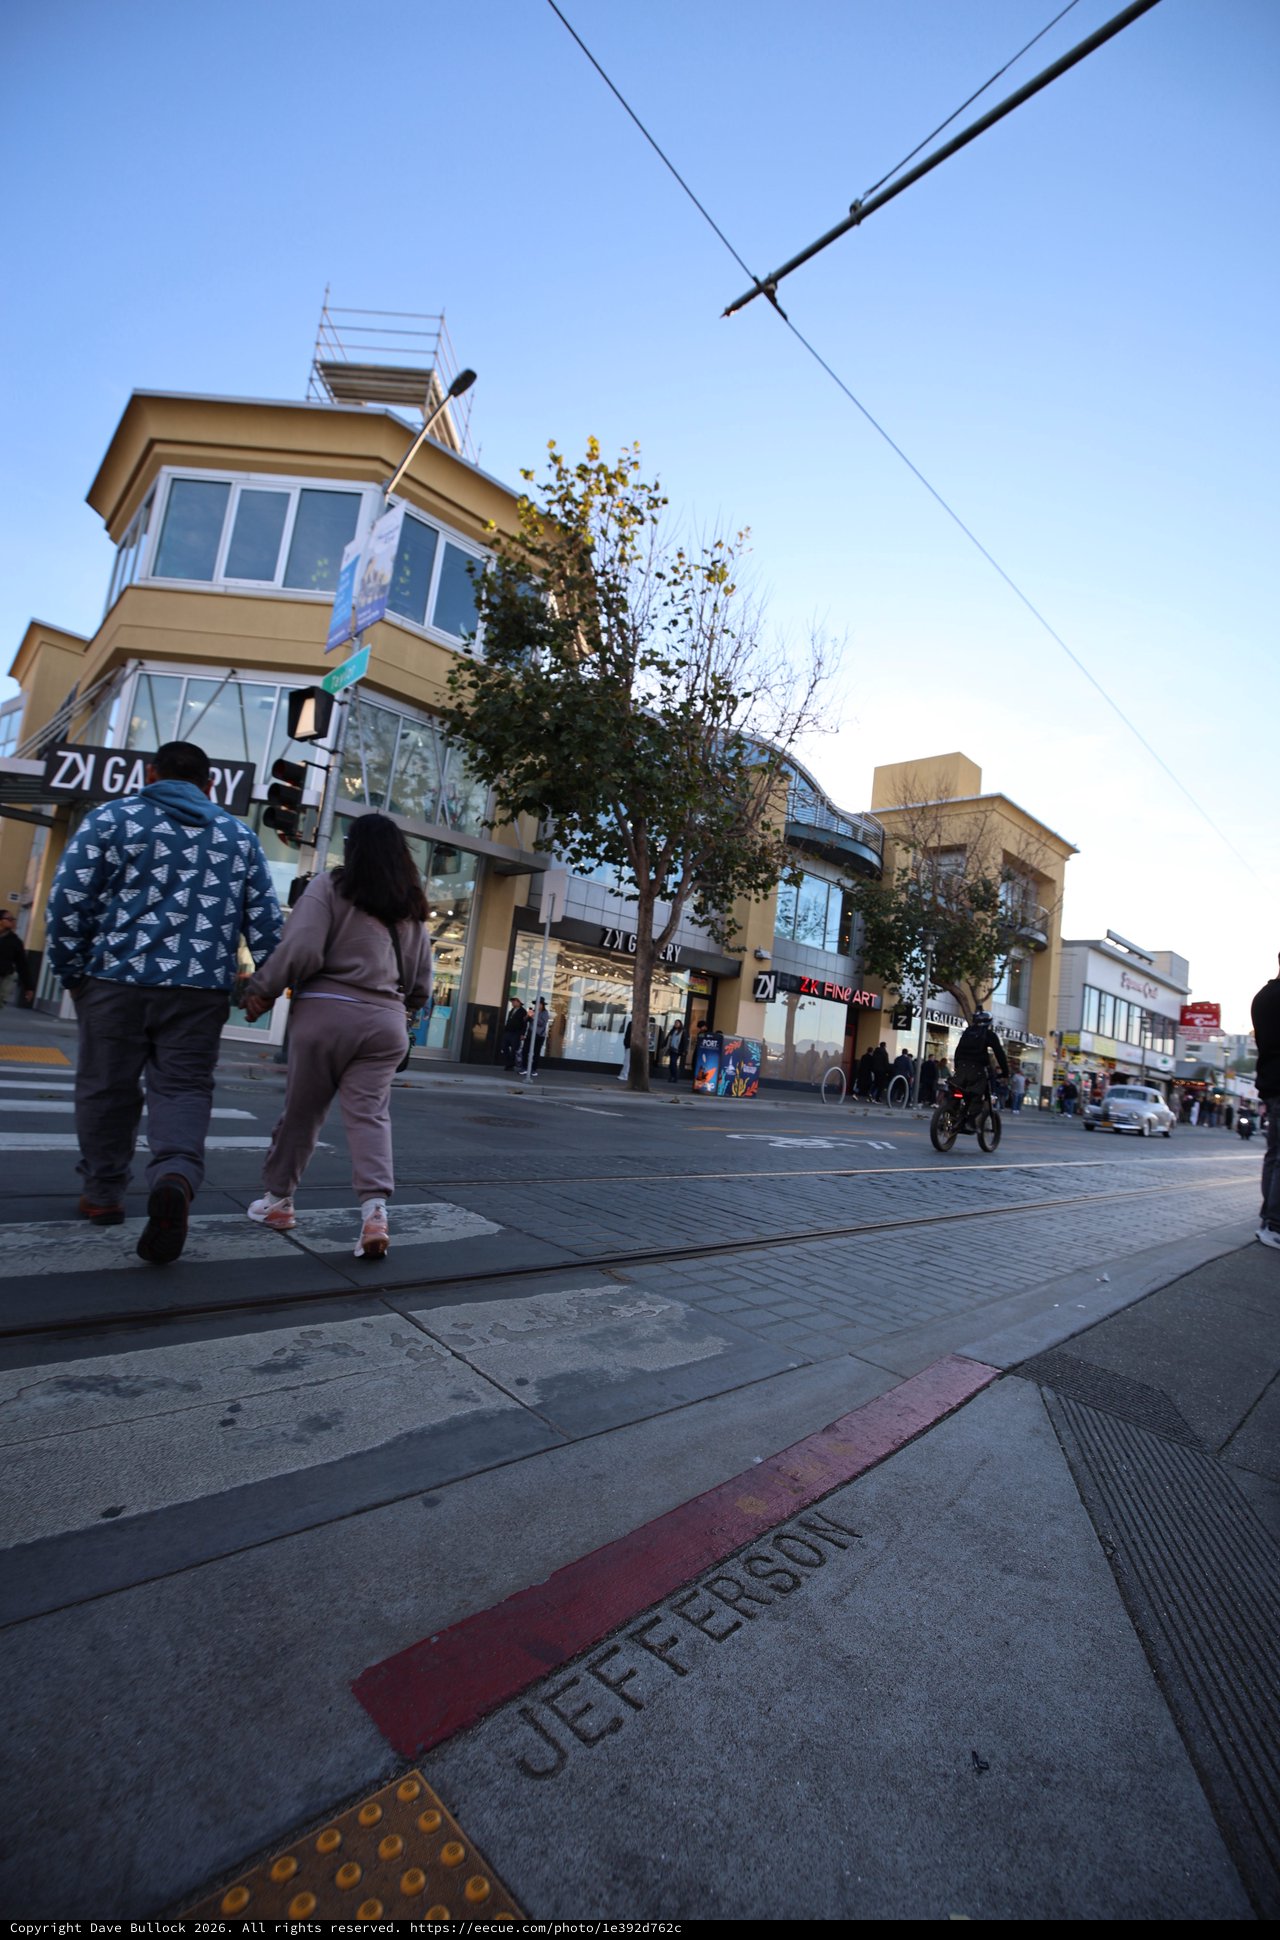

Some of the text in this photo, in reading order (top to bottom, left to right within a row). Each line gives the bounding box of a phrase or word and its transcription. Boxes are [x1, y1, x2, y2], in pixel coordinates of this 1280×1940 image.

[102, 756, 244, 806] GARY
[628, 934, 682, 963] GERY
[800, 975, 819, 995] ZK
[852, 988, 878, 1008] ART
[897, 1015, 907, 1027] Z
[517, 1510, 863, 1781] JEFFERSON
